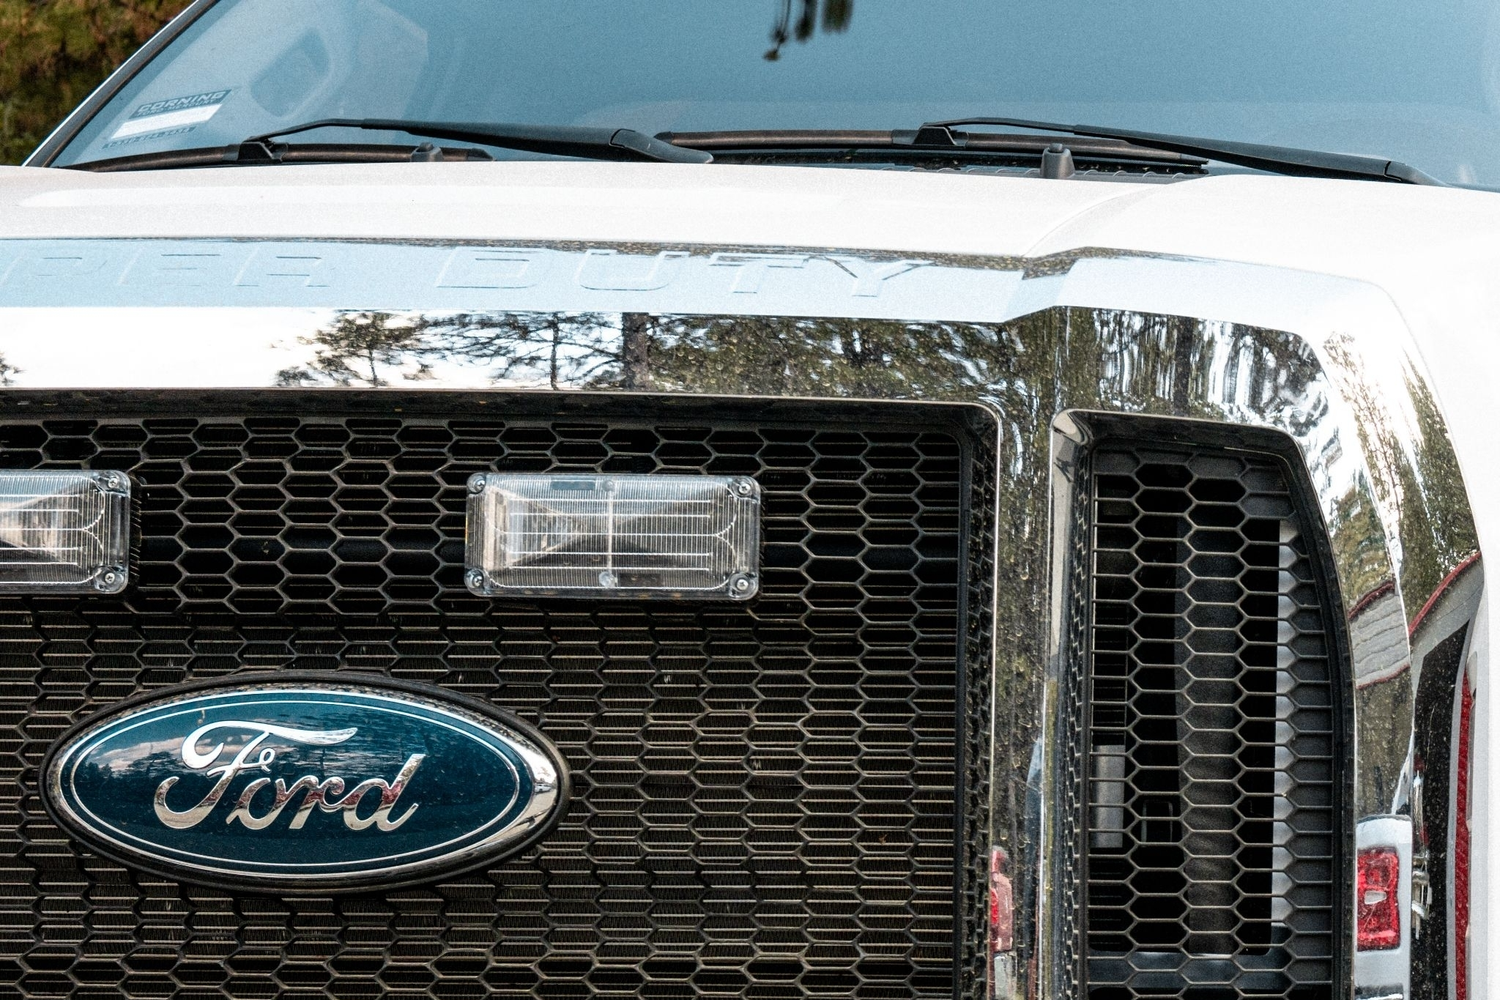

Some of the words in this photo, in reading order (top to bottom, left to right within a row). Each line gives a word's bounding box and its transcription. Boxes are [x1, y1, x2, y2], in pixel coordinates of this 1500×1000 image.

[137, 91, 226, 112] CORNING
[436, 245, 932, 298] DUTY
[154, 720, 426, 832] Ford
